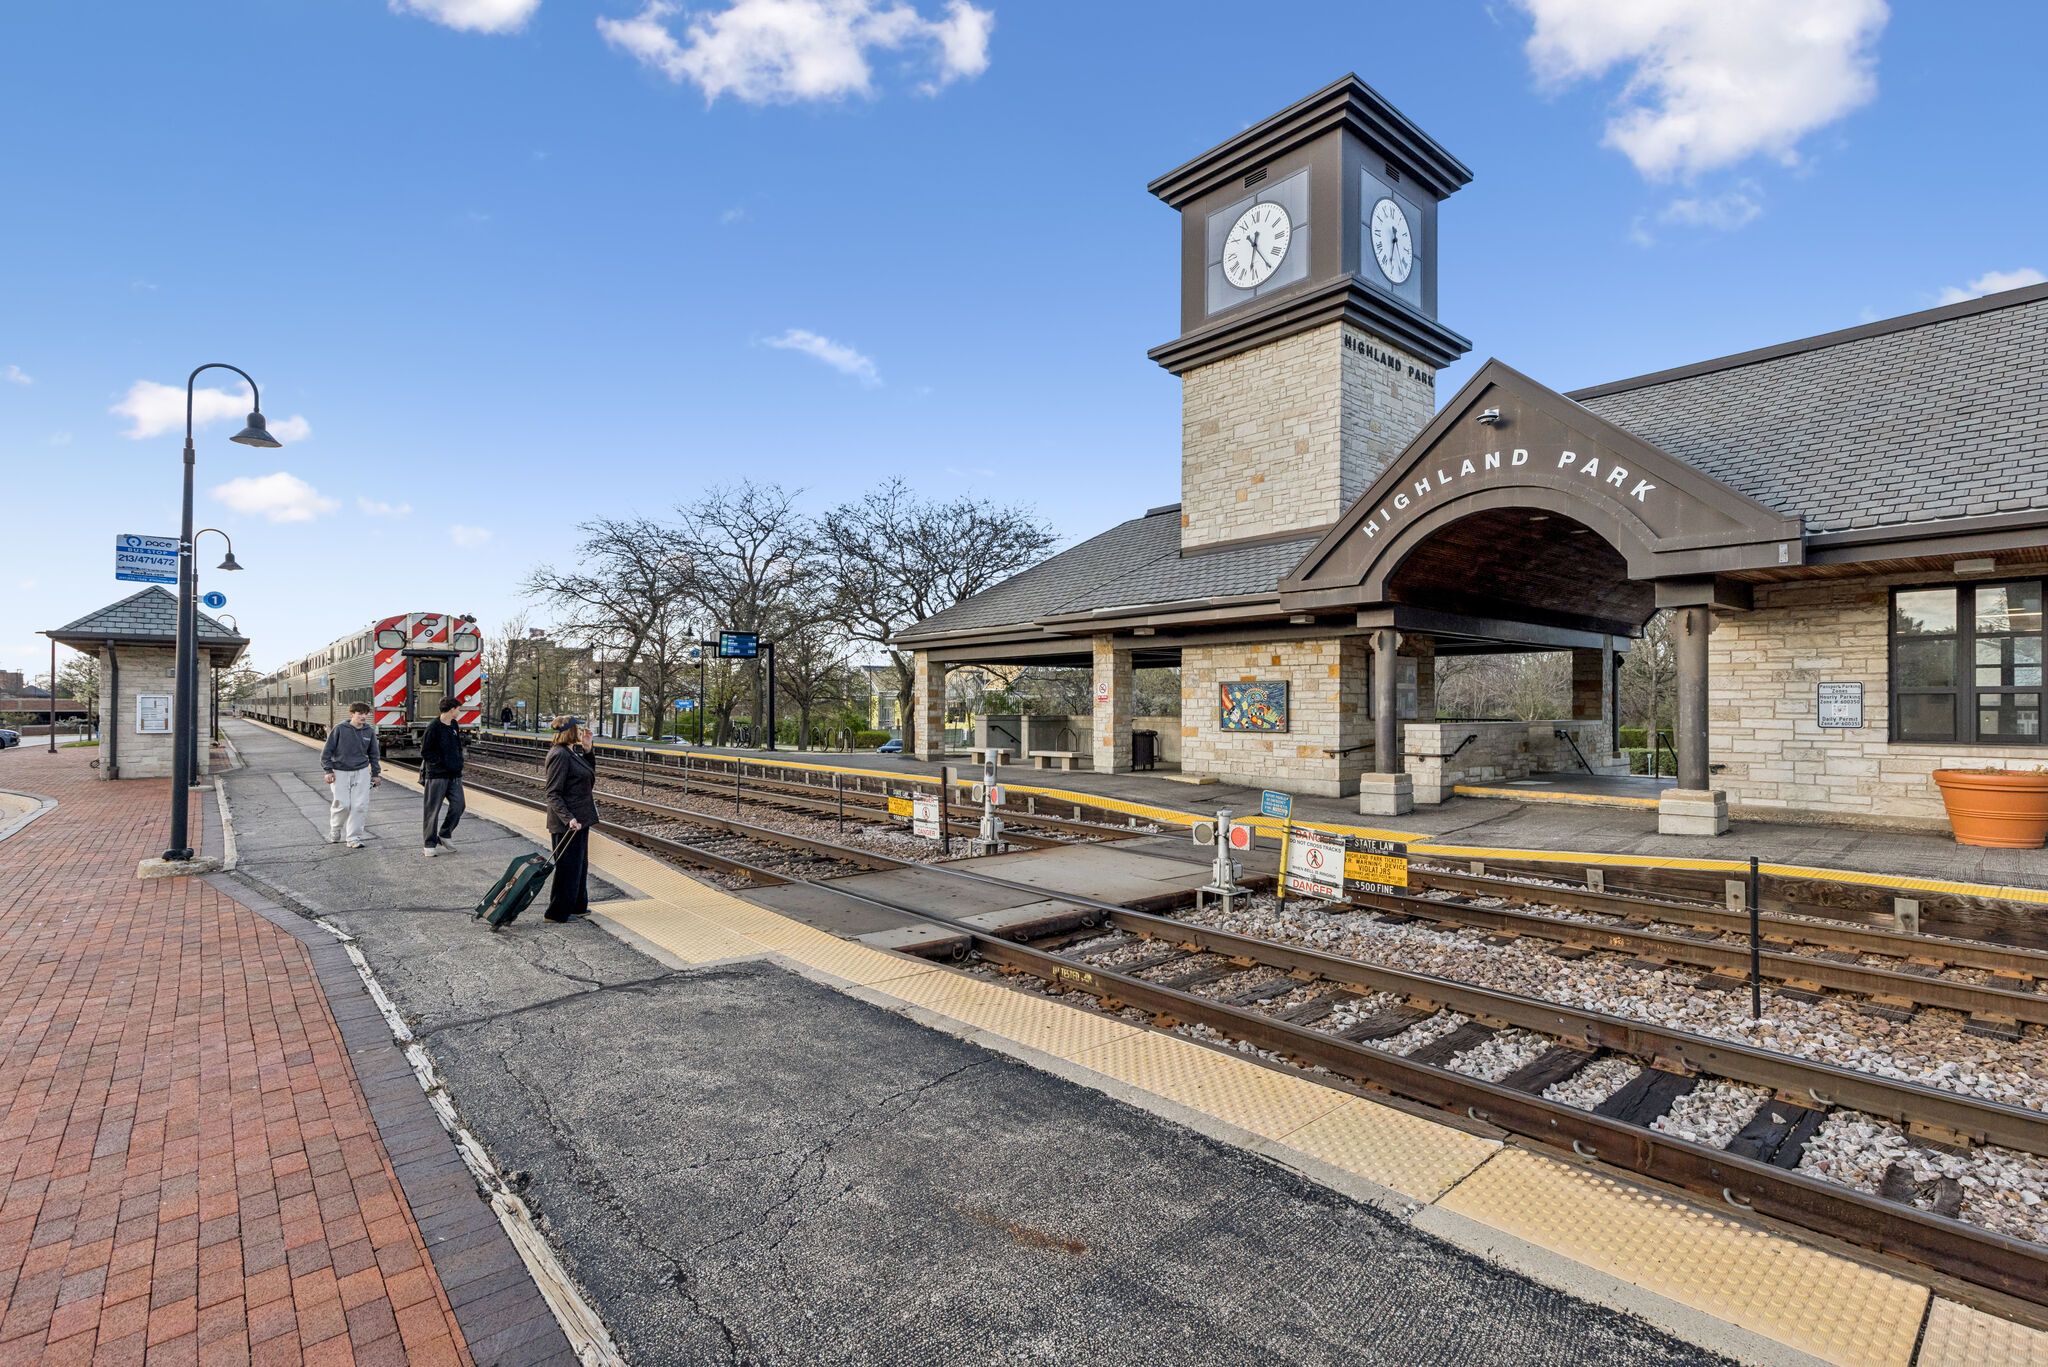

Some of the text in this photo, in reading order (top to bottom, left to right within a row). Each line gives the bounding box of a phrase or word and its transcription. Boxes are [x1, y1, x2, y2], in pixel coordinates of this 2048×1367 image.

[1344, 334, 1434, 388] HIGHLAND PARK
[1362, 448, 1657, 538] HIGHLAND PARK
[118, 554, 175, 566] 213/471/472
[212, 596, 218, 604] 1
[1323, 845, 1341, 853] TRACKS
[1354, 839, 1376, 850] STATE
[1380, 841, 1394, 851] LAW
[1293, 879, 1333, 895] DANGER
[1355, 881, 1394, 895] $500 FINE
